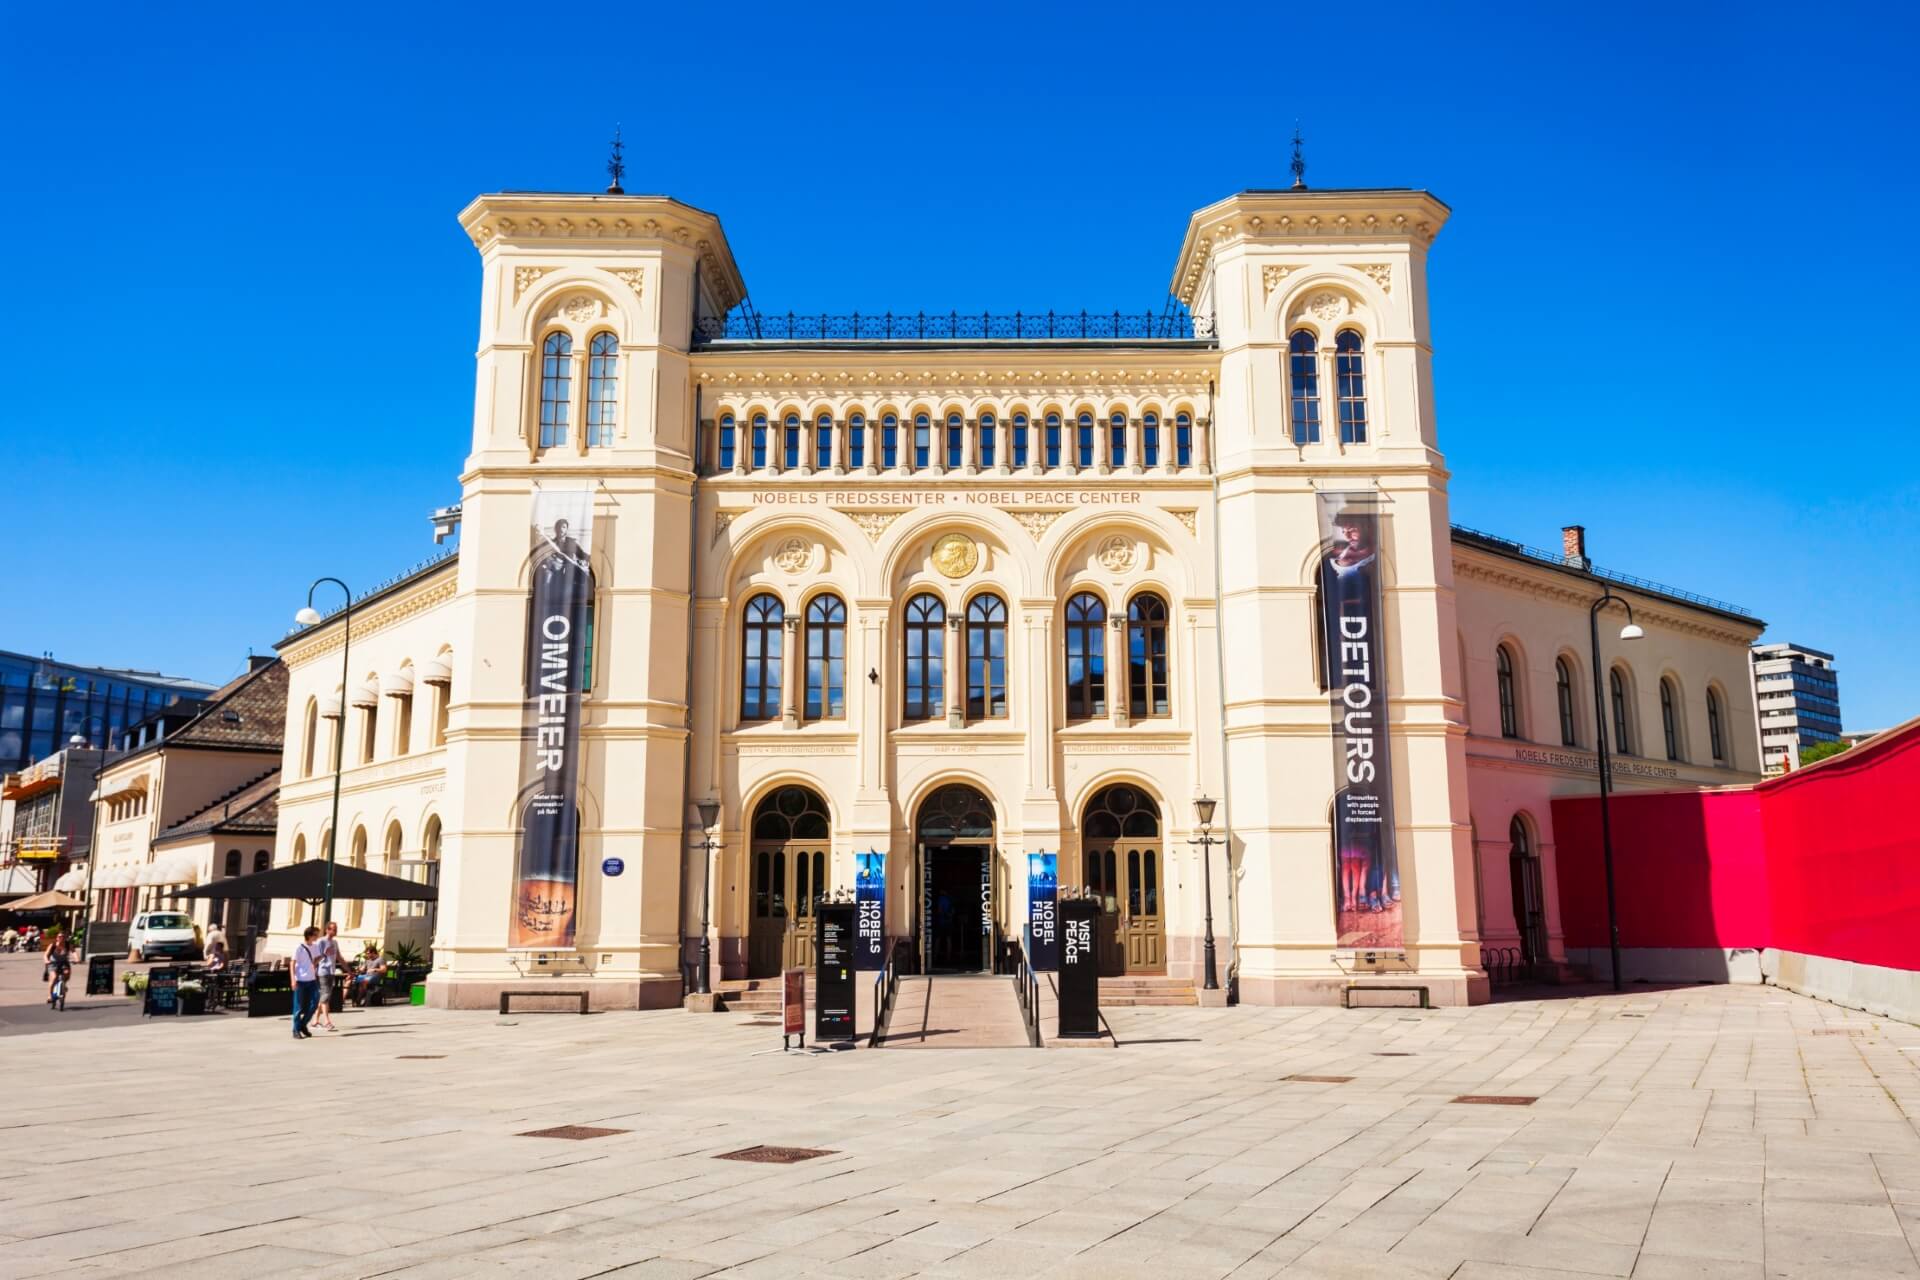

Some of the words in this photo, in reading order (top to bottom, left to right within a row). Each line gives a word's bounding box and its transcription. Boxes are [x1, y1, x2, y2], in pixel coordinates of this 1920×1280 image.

[752, 492, 818, 504] NOBELS
[825, 492, 945, 504] FREDSSENTER
[965, 492, 1019, 504] NOBEL
[1025, 492, 1075, 504] PEACE
[1079, 492, 1141, 504] CENTER
[536, 615, 570, 772] OMVEIER
[1339, 616, 1376, 783] DETOURS
[1515, 748, 1548, 763] NOBELS
[1550, 752, 1600, 769] FREDSSENTE
[1632, 764, 1653, 776] PEACE
[1654, 767, 1677, 778] CENTER
[859, 900, 870, 938] HAGE
[981, 861, 993, 935] WELCOME
[1032, 901, 1043, 938] FIELD
[870, 900, 881, 954] NOBELS
[1043, 901, 1054, 946] NOBEL
[1065, 920, 1078, 964] PEACE
[1078, 919, 1090, 953] VISIT
